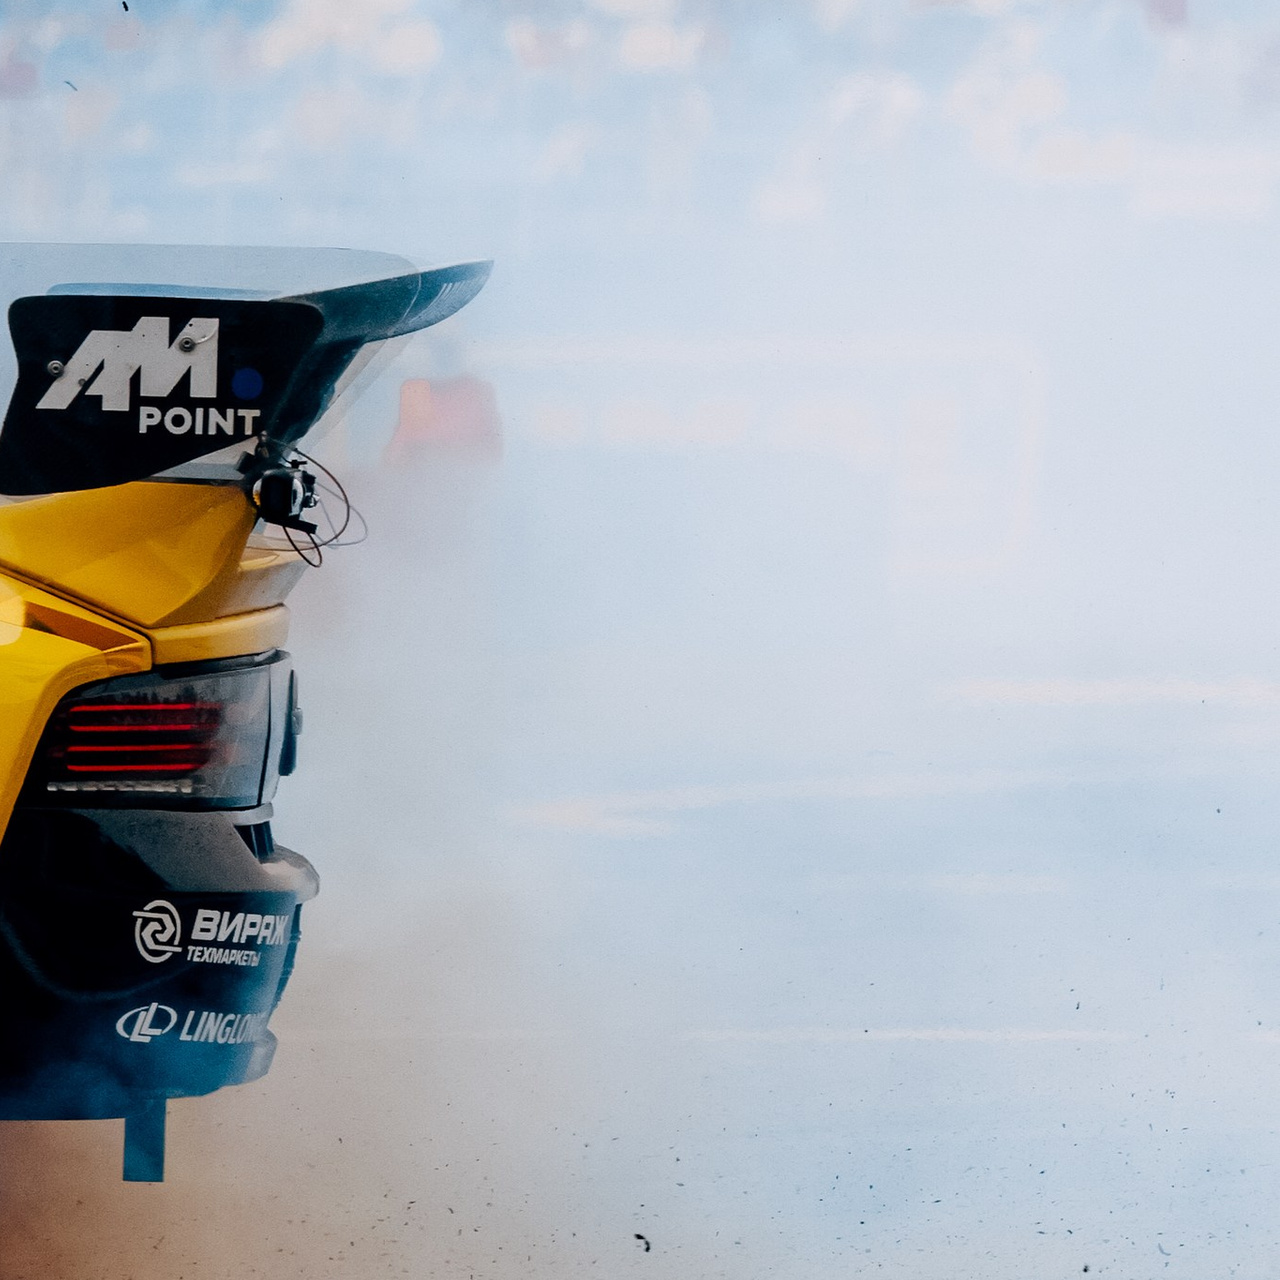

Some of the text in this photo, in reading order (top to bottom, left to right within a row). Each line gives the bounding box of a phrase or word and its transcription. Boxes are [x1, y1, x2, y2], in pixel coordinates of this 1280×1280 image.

[138, 406, 261, 436] POINT
[190, 908, 289, 945] ВИРАЖ
[186, 945, 262, 967] ТЕХМАРКЕТЫ
